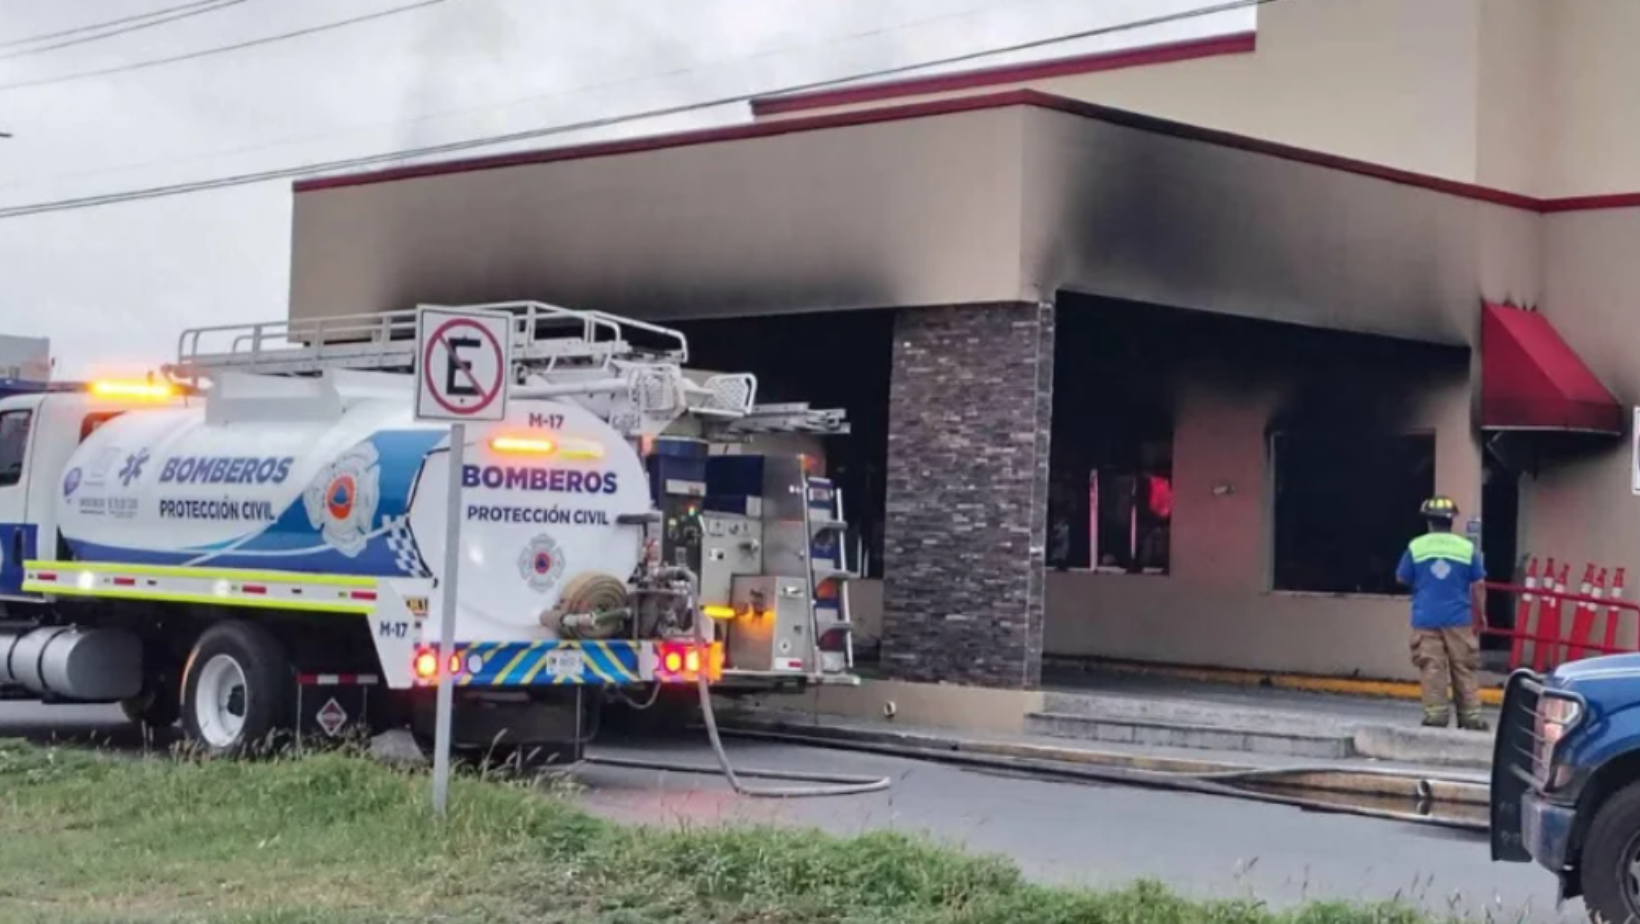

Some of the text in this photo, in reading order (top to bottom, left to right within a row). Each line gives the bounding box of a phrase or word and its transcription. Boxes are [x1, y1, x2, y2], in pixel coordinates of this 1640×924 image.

[446, 336, 482, 396] E
[528, 412, 564, 429] M-17
[159, 456, 294, 484] BOMBEROS
[461, 464, 617, 494] BOMBEROS
[159, 494, 239, 521] PROTECCIÓN
[242, 501, 276, 521] CIVIL
[467, 504, 609, 525] PROTECCIÓN CIVIL
[380, 620, 408, 638] M-17
